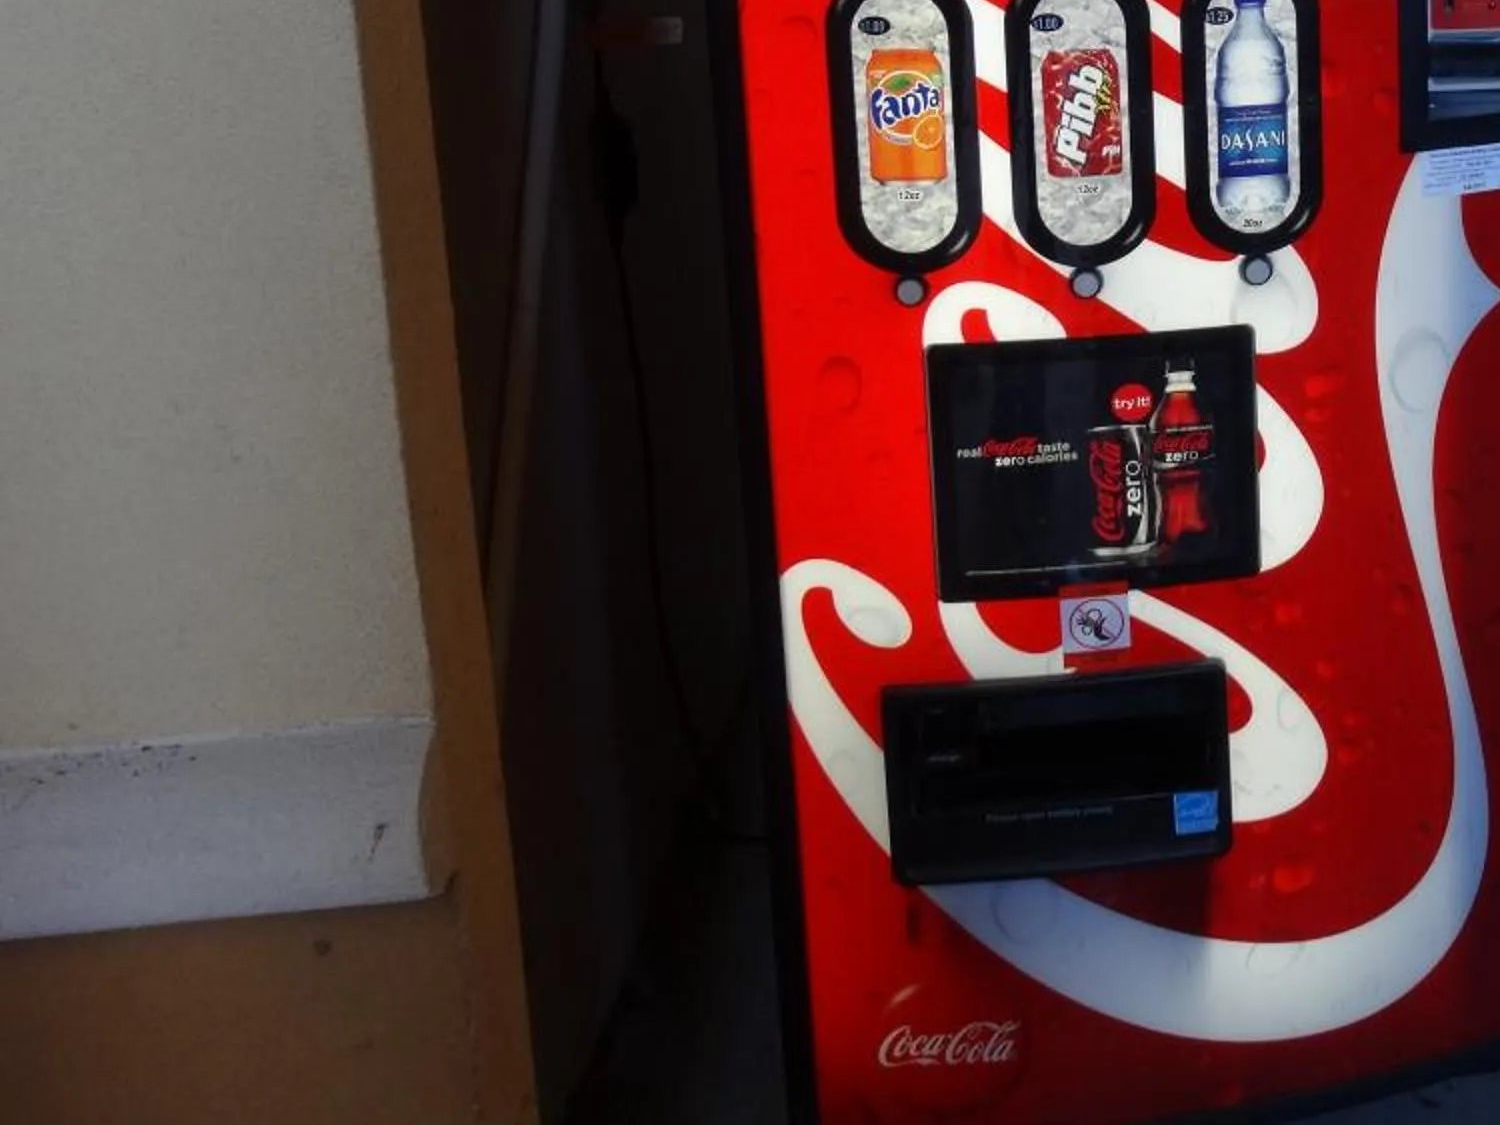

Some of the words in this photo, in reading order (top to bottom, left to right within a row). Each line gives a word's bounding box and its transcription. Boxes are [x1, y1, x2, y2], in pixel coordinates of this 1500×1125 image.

[1056, 65, 1103, 165] Pibb
[1221, 128, 1285, 151] DASANI
[1113, 397, 1135, 411] try
[995, 456, 1026, 467] zero
[1027, 449, 1079, 464] calories
[1165, 451, 1199, 462] zero
[1126, 460, 1143, 517] zero
[878, 1021, 1021, 1067] Coca-Cola
